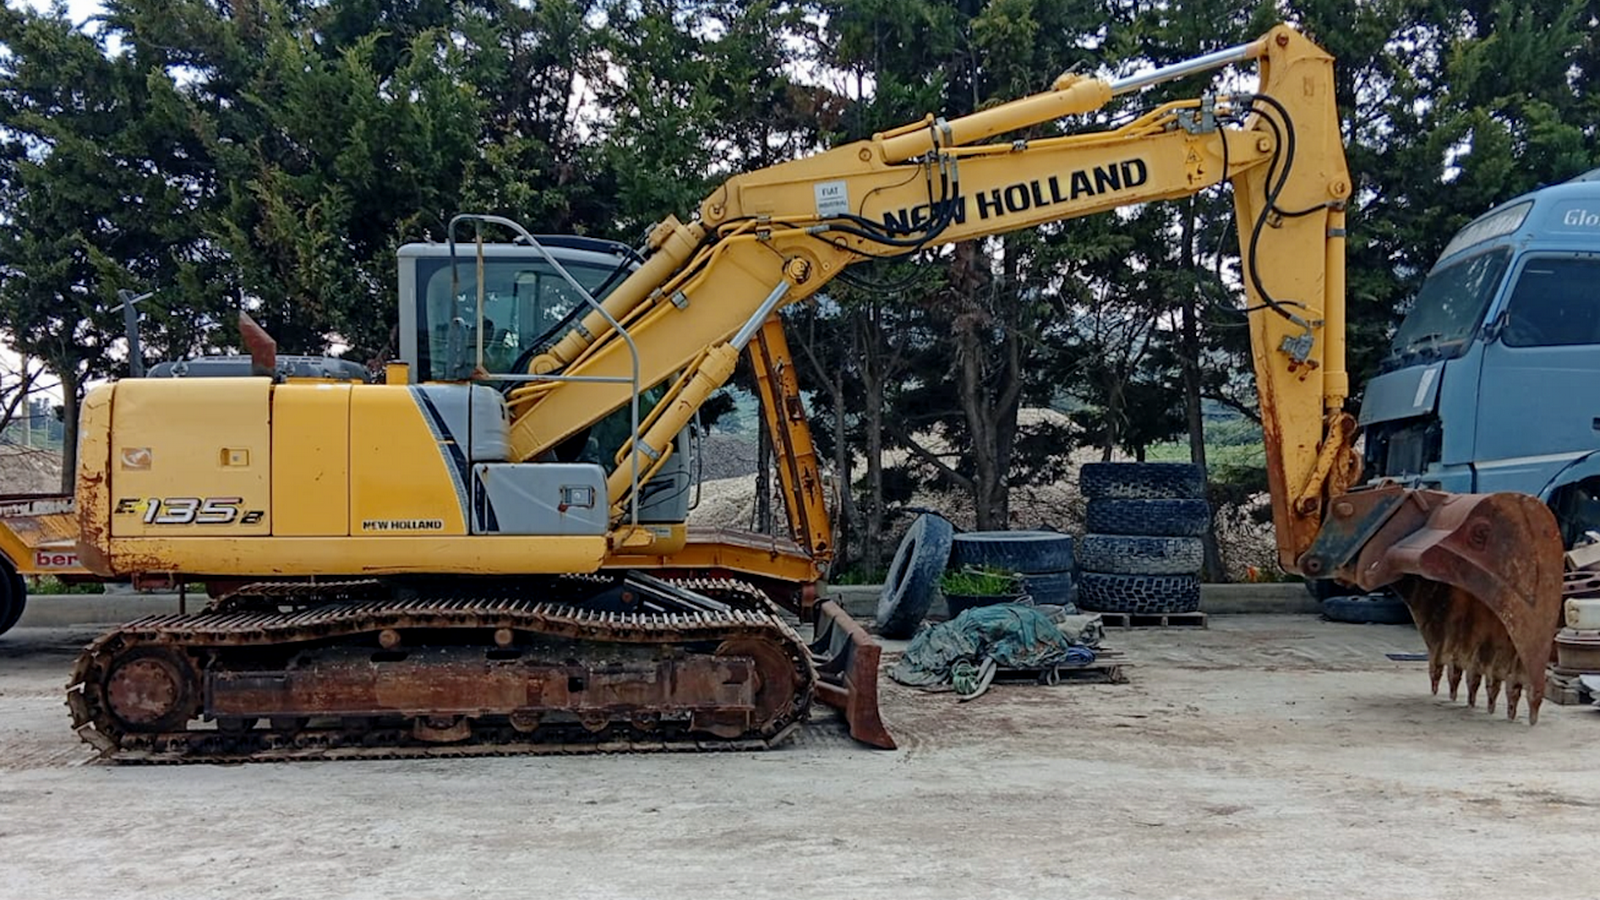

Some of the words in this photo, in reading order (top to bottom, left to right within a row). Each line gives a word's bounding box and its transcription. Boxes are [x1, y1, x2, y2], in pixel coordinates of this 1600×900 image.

[821, 186, 839, 196] FIAT
[976, 158, 1148, 220] HOLLAND
[1564, 208, 1600, 226] Glo
[362, 521, 389, 530] NEW
[391, 520, 442, 530] HOLLAND
